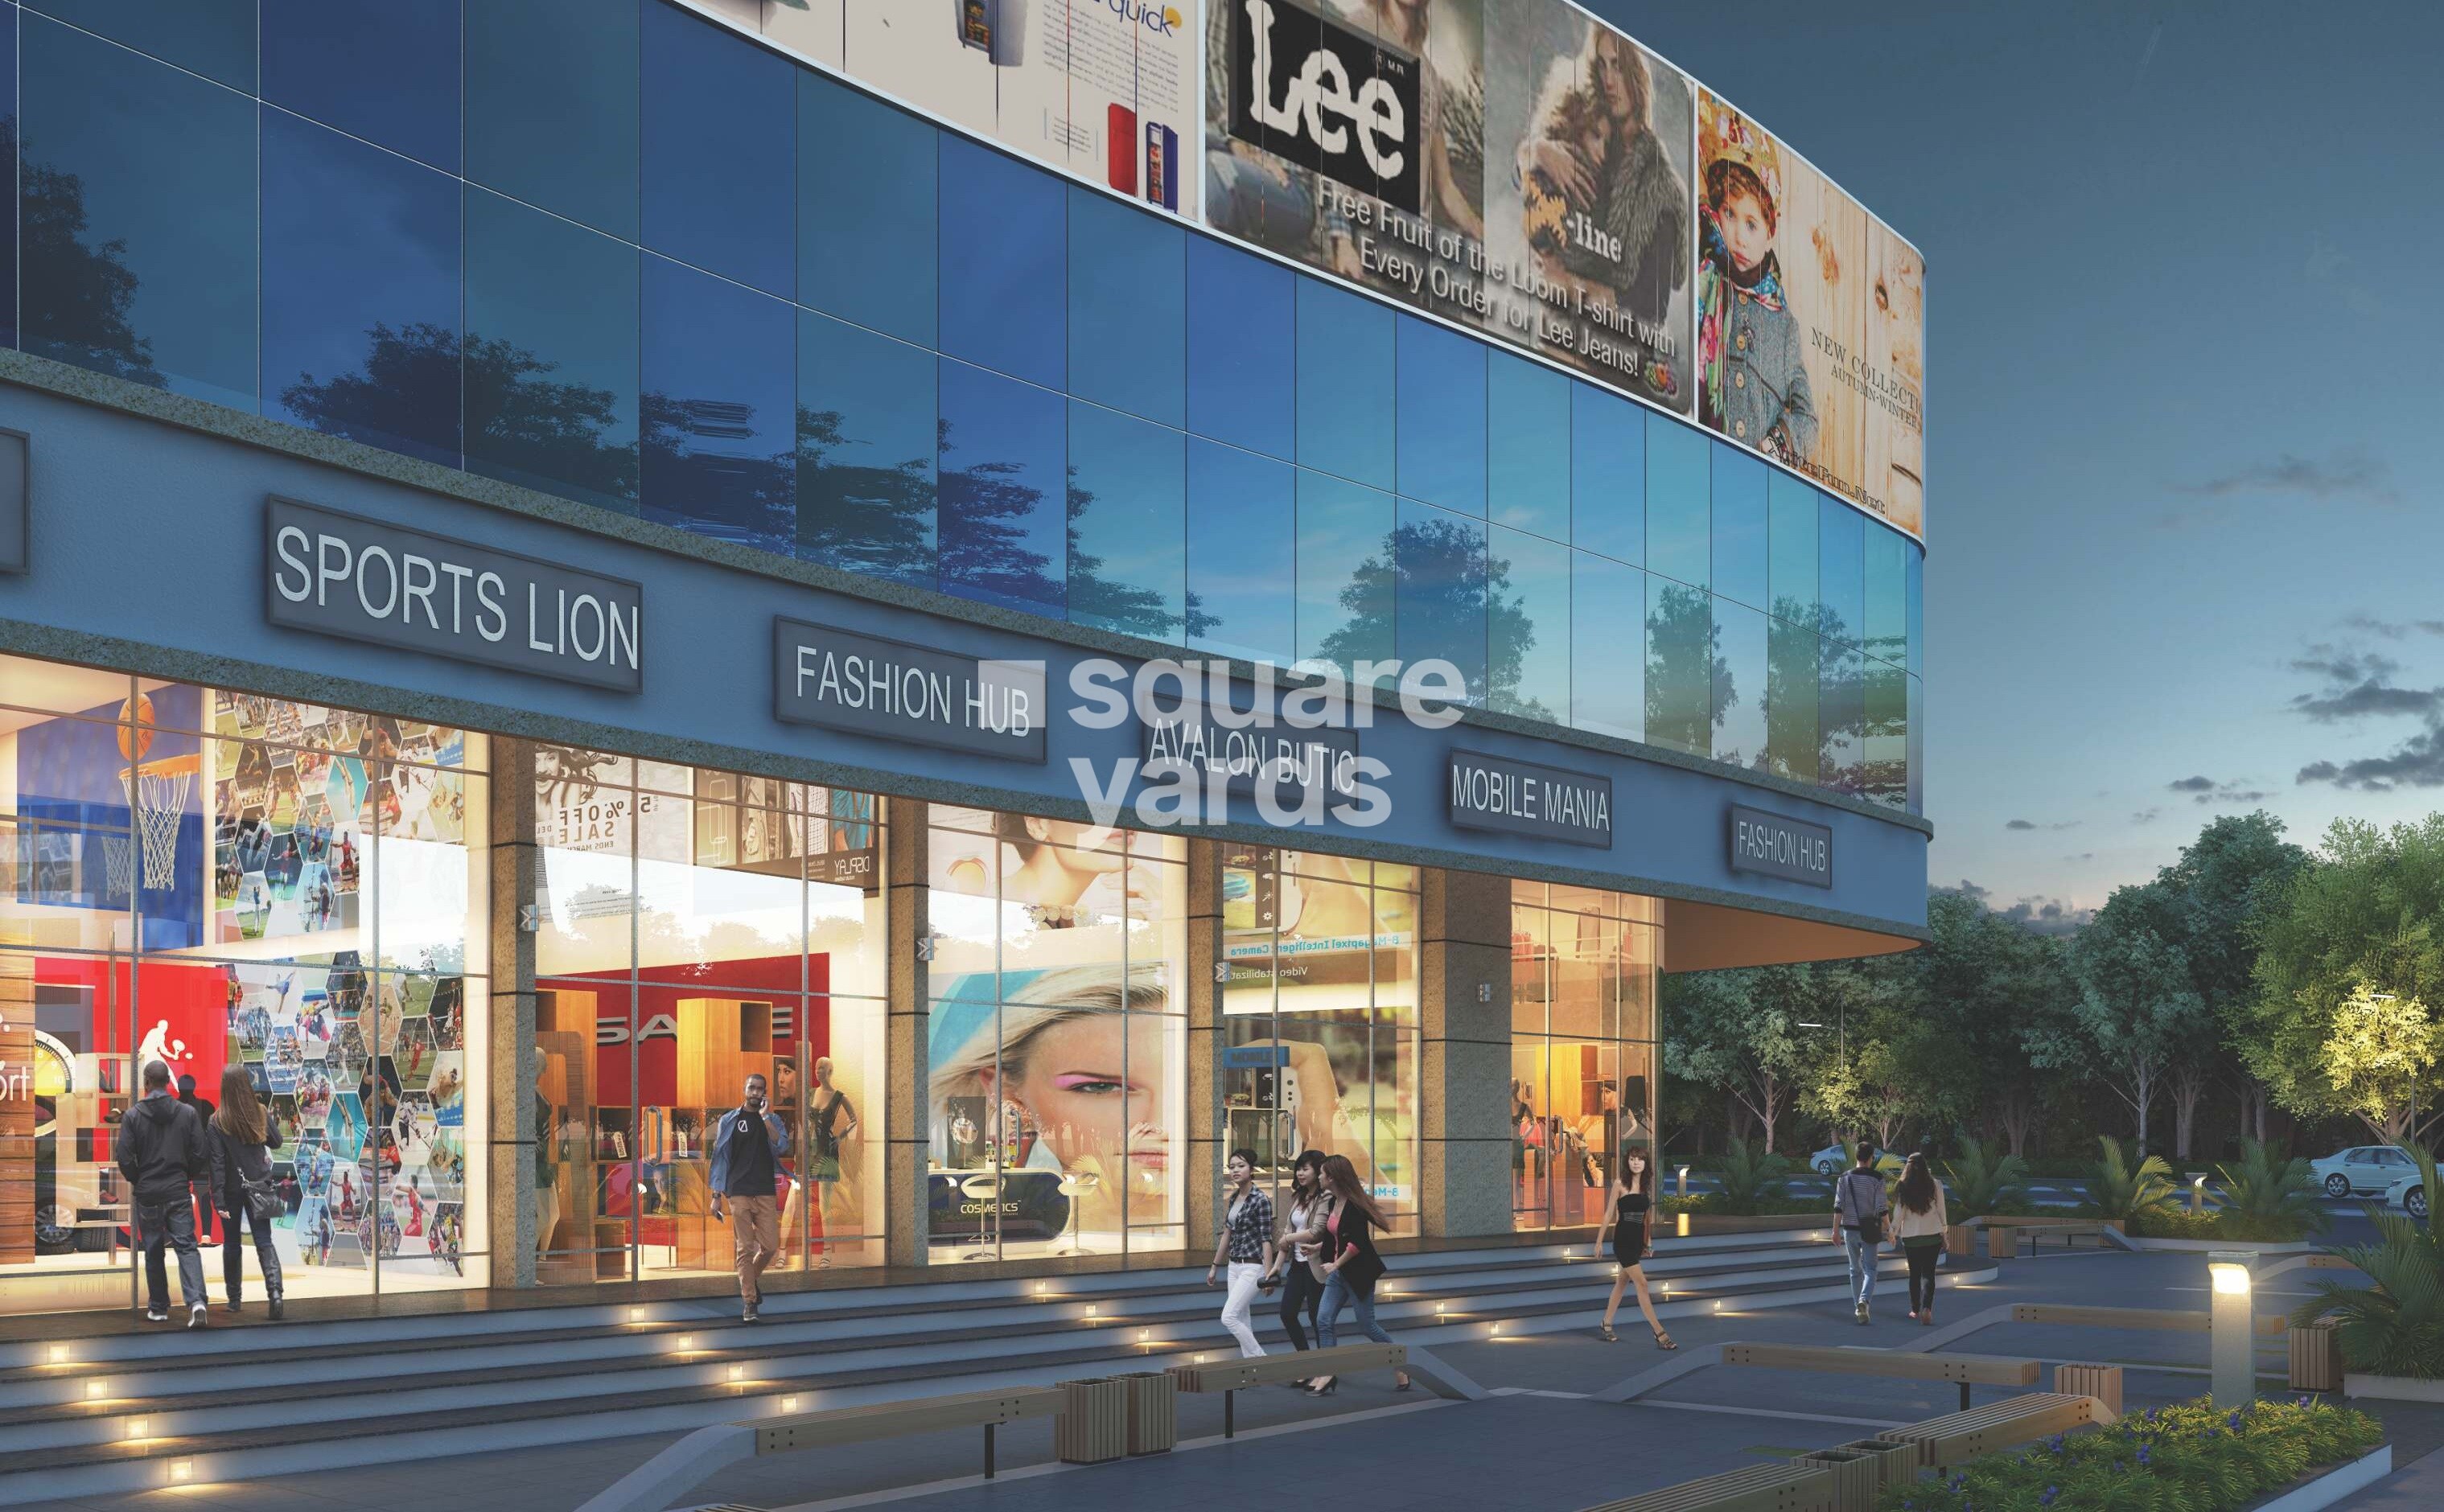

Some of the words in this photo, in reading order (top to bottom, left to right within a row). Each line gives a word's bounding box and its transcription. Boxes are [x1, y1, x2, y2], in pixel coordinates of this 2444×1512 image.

[1246, 0, 1405, 179] Lee
[1318, 175, 1371, 224] Free
[1380, 202, 1432, 252] Fruit
[1439, 233, 1463, 263] of
[1469, 243, 1504, 280] the
[1512, 261, 1567, 309] Loom
[1574, 285, 1634, 338] T-shirt
[1638, 321, 1675, 357] with
[1360, 236, 1423, 294] Every
[1431, 266, 1492, 315] Order
[1504, 302, 1533, 331] for
[1539, 309, 1575, 349] Lee
[1579, 328, 1639, 376] Jeans!
[1812, 327, 1846, 364] NEW
[1831, 364, 1917, 429] AUTUMN-WINTER
[274, 526, 507, 643] SPORTS
[529, 581, 639, 671] LION
[796, 645, 951, 725] FASHION
[965, 677, 1030, 738] HUB
[1150, 716, 1274, 780] AVALON
[1277, 738, 1356, 797] BUTIC
[1452, 764, 1537, 820] MOBILE
[1545, 782, 1611, 832] MANIA
[1738, 821, 1796, 866] FASHION
[1801, 836, 1826, 873] HUB
[597, 1007, 793, 1044] SAE
[960, 1202, 1018, 1214] COSMEICS
